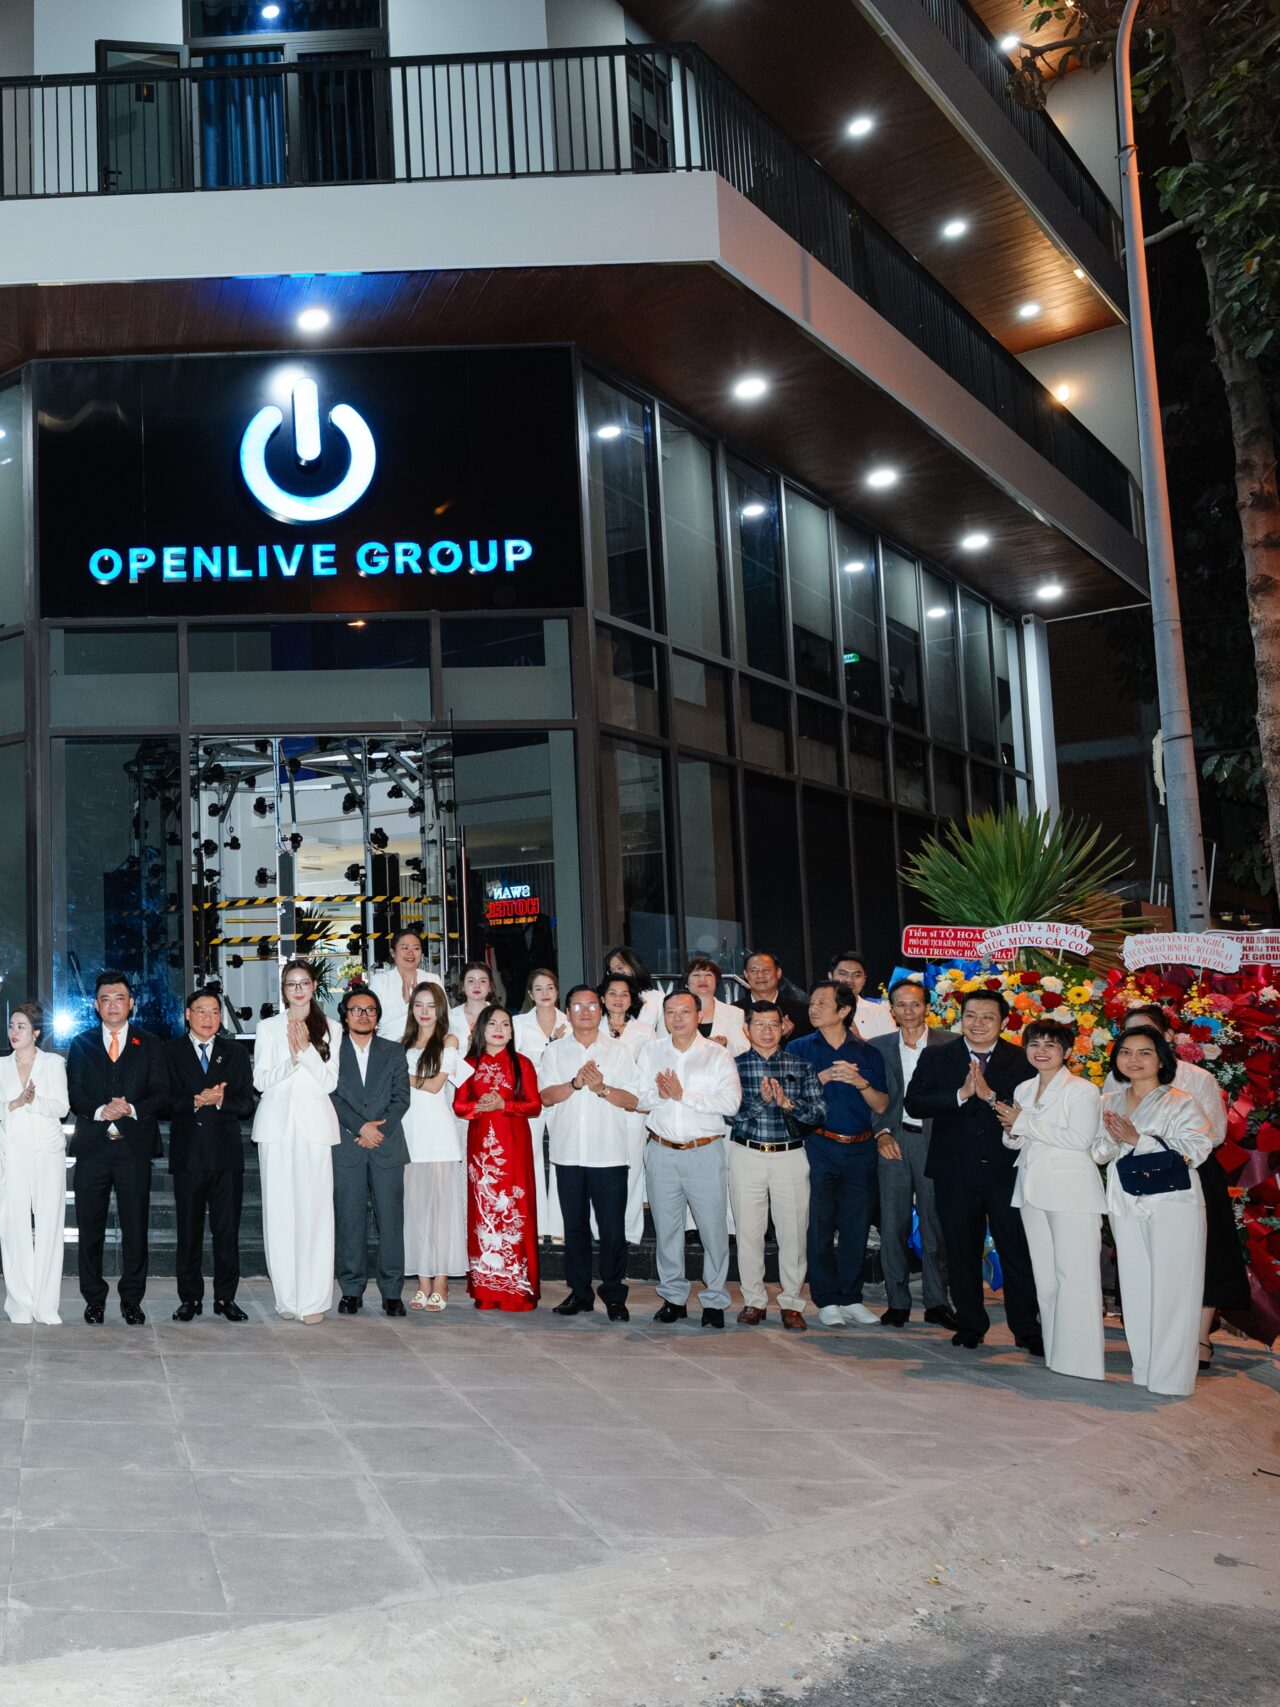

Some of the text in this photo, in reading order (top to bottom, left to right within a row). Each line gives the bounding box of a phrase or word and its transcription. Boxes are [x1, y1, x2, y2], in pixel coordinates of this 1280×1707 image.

[89, 539, 532, 582] OPENLIVE GROUP
[908, 928, 927, 937] Tiến
[983, 928, 1002, 940] Cha
[1046, 924, 1061, 937] Mẹ
[907, 947, 927, 955] KHAI
[929, 947, 963, 957] TRƯƠNG
[979, 934, 1092, 955] CHÚC MỪNG CÁC CON
